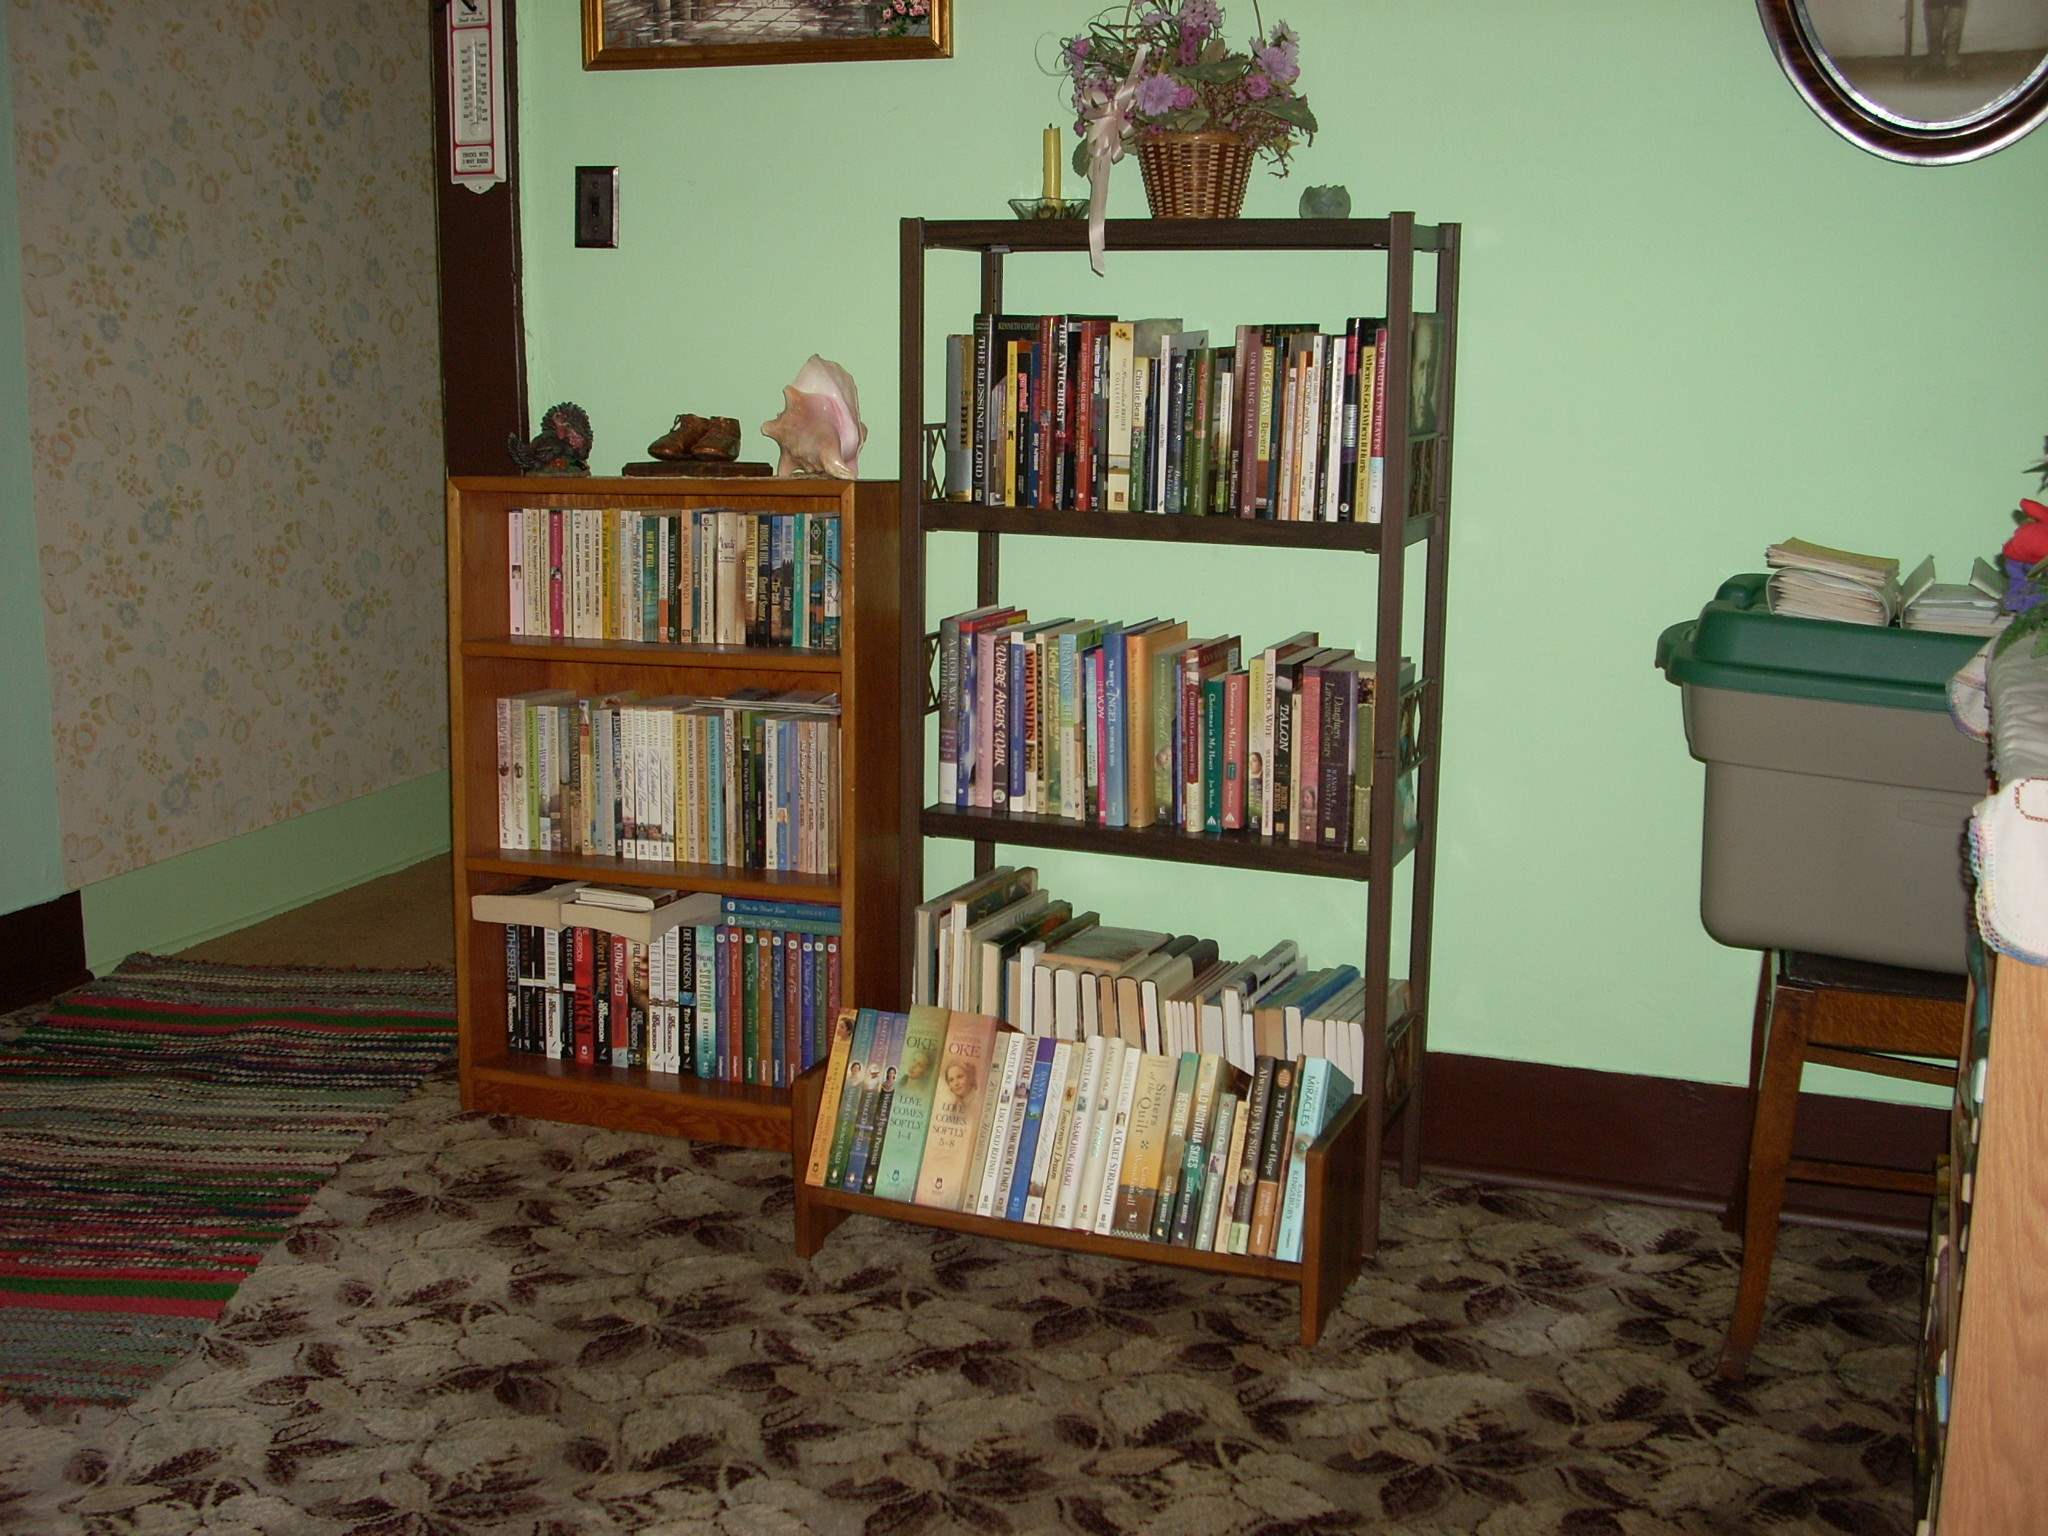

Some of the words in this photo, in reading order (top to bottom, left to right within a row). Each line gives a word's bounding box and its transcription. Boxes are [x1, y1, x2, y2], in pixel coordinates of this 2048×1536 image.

[977, 336, 987, 365] THE
[1058, 324, 1067, 346] THE
[1263, 349, 1273, 371] BAIT
[1364, 353, 1373, 382] Where
[1376, 355, 1385, 395] MINUTES
[1056, 352, 1067, 425] ANTICHRIST
[1247, 351, 1257, 405] UNVEILING
[1263, 373, 1271, 384] OF
[976, 367, 987, 429] BLESSING
[1133, 401, 1143, 422] Bear
[1261, 386, 1271, 416] SATAN
[1363, 394, 1371, 412] God
[1246, 408, 1255, 438] ISLAM
[1373, 415, 1383, 450] HEAVEN
[975, 444, 986, 478] LORD
[994, 645, 1007, 688] WHERE
[1048, 646, 1060, 679] Keller
[1278, 703, 1290, 753] TALON
[1331, 696, 1345, 740] Daughters
[613, 942, 625, 997] KIDNAPPED
[683, 943, 693, 990] HENDERSON
[699, 969, 712, 1013] SUSPICION
[947, 1042, 981, 1059] OKE
[1024, 1037, 1037, 1065] JANETTE
[1253, 1066, 1269, 1103] Always
[1277, 1092, 1287, 1108] The
[1013, 1102, 1025, 1122] WHEN
[1134, 1096, 1152, 1135] Quilt
[1149, 1083, 1169, 1127] Sisters
[1299, 1075, 1317, 1128] MIRACLES
[1171, 1125, 1182, 1138] ME
[1191, 1104, 1208, 1144] MONTANA
[1005, 1124, 1020, 1165] TOMORROW
[1110, 1136, 1124, 1162] QUIET
[1186, 1144, 1201, 1169] SKIES
[1269, 1143, 1278, 1153] of
[1050, 1151, 1063, 1181] Dream
[1265, 1153, 1278, 1177] Hope
[1102, 1162, 1118, 1206] STRENGTH
